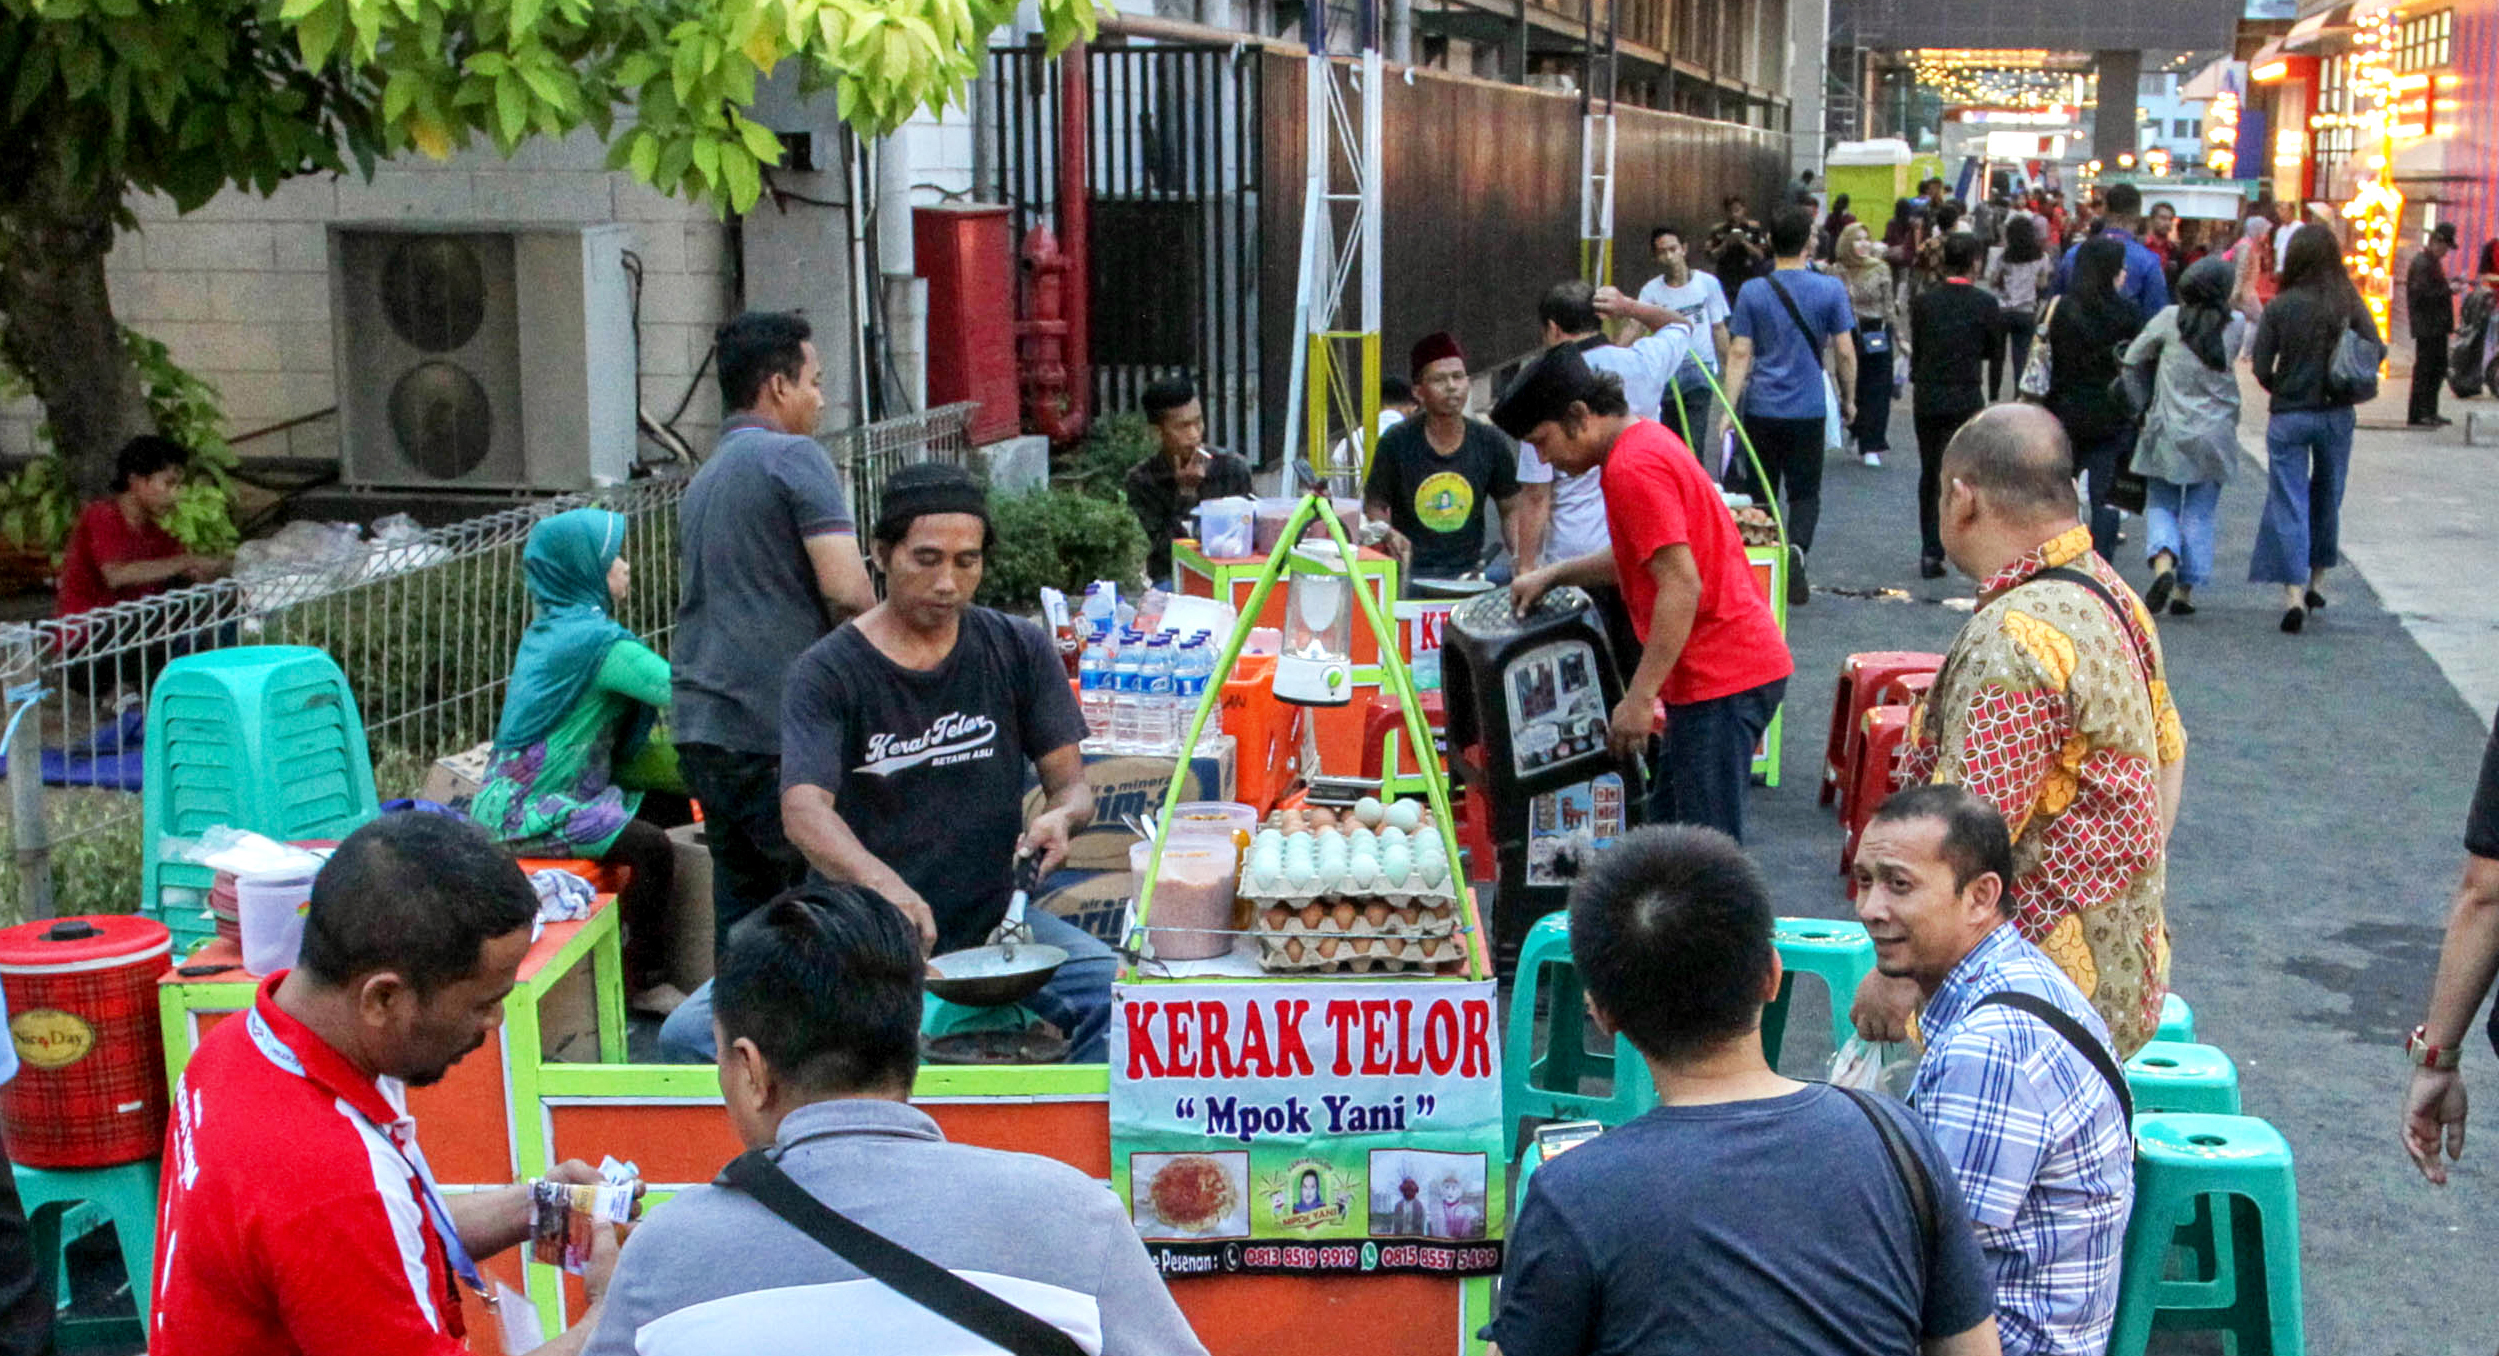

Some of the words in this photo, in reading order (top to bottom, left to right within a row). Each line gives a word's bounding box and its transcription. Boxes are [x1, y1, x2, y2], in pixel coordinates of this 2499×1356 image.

[1421, 611, 1451, 651] K
[931, 711, 988, 745] Telor
[931, 752, 970, 767] BETAWI
[972, 748, 993, 760] ASLI
[50, 1030, 83, 1048] Day
[1125, 999, 1314, 1080] KERAK
[1325, 999, 1492, 1078] TELOR
[1205, 1096, 1312, 1142] Mpok
[1321, 1094, 1407, 1133] Yani
[1244, 1247, 1281, 1267] 0813
[1282, 1247, 1317, 1268] 8519
[1319, 1246, 1357, 1268] 9919
[1381, 1245, 1418, 1267] 0815
[1419, 1247, 1456, 1269] 8557
[1457, 1247, 1498, 1270] 5499
